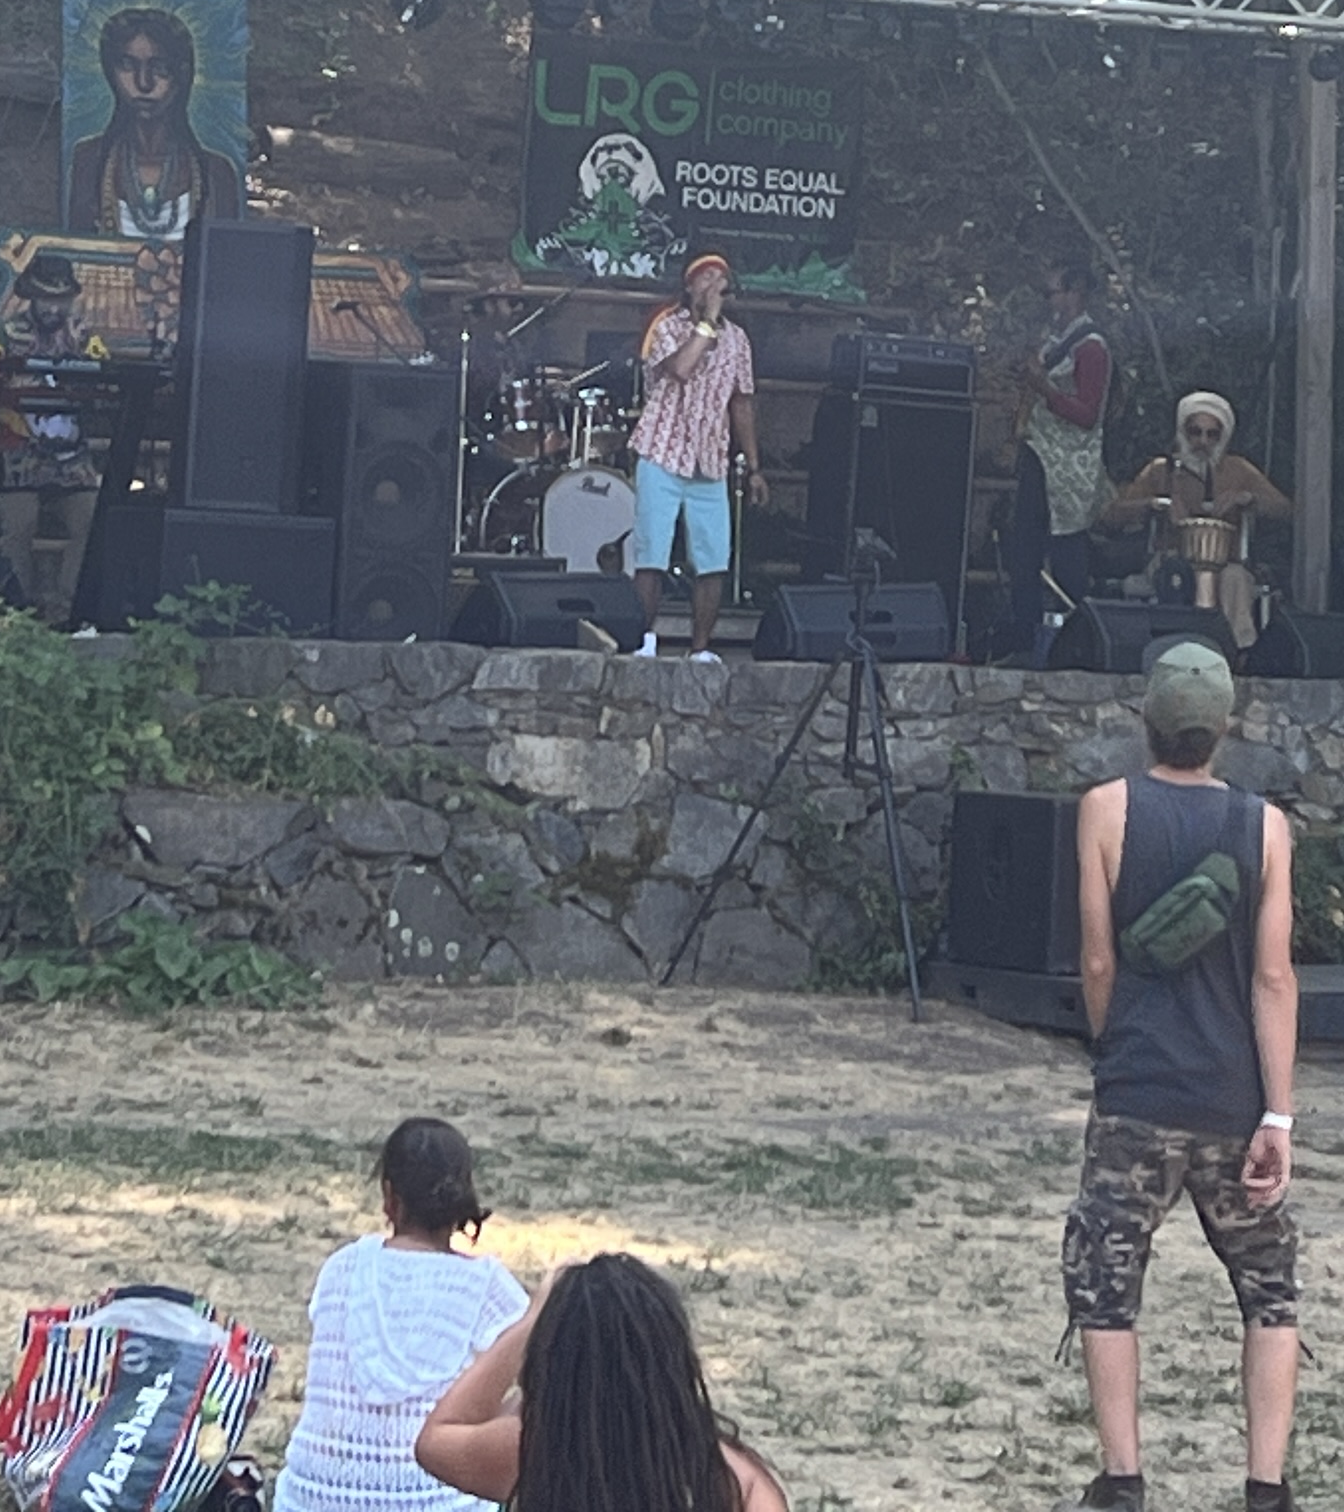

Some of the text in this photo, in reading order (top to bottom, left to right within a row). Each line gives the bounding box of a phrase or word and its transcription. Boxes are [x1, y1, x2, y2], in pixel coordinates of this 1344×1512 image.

[534, 59, 701, 136] LRG
[719, 75, 833, 119] clothing
[717, 110, 851, 150] company
[675, 160, 845, 196] ROOTS EQUAL
[682, 186, 836, 220] FOUNDATION
